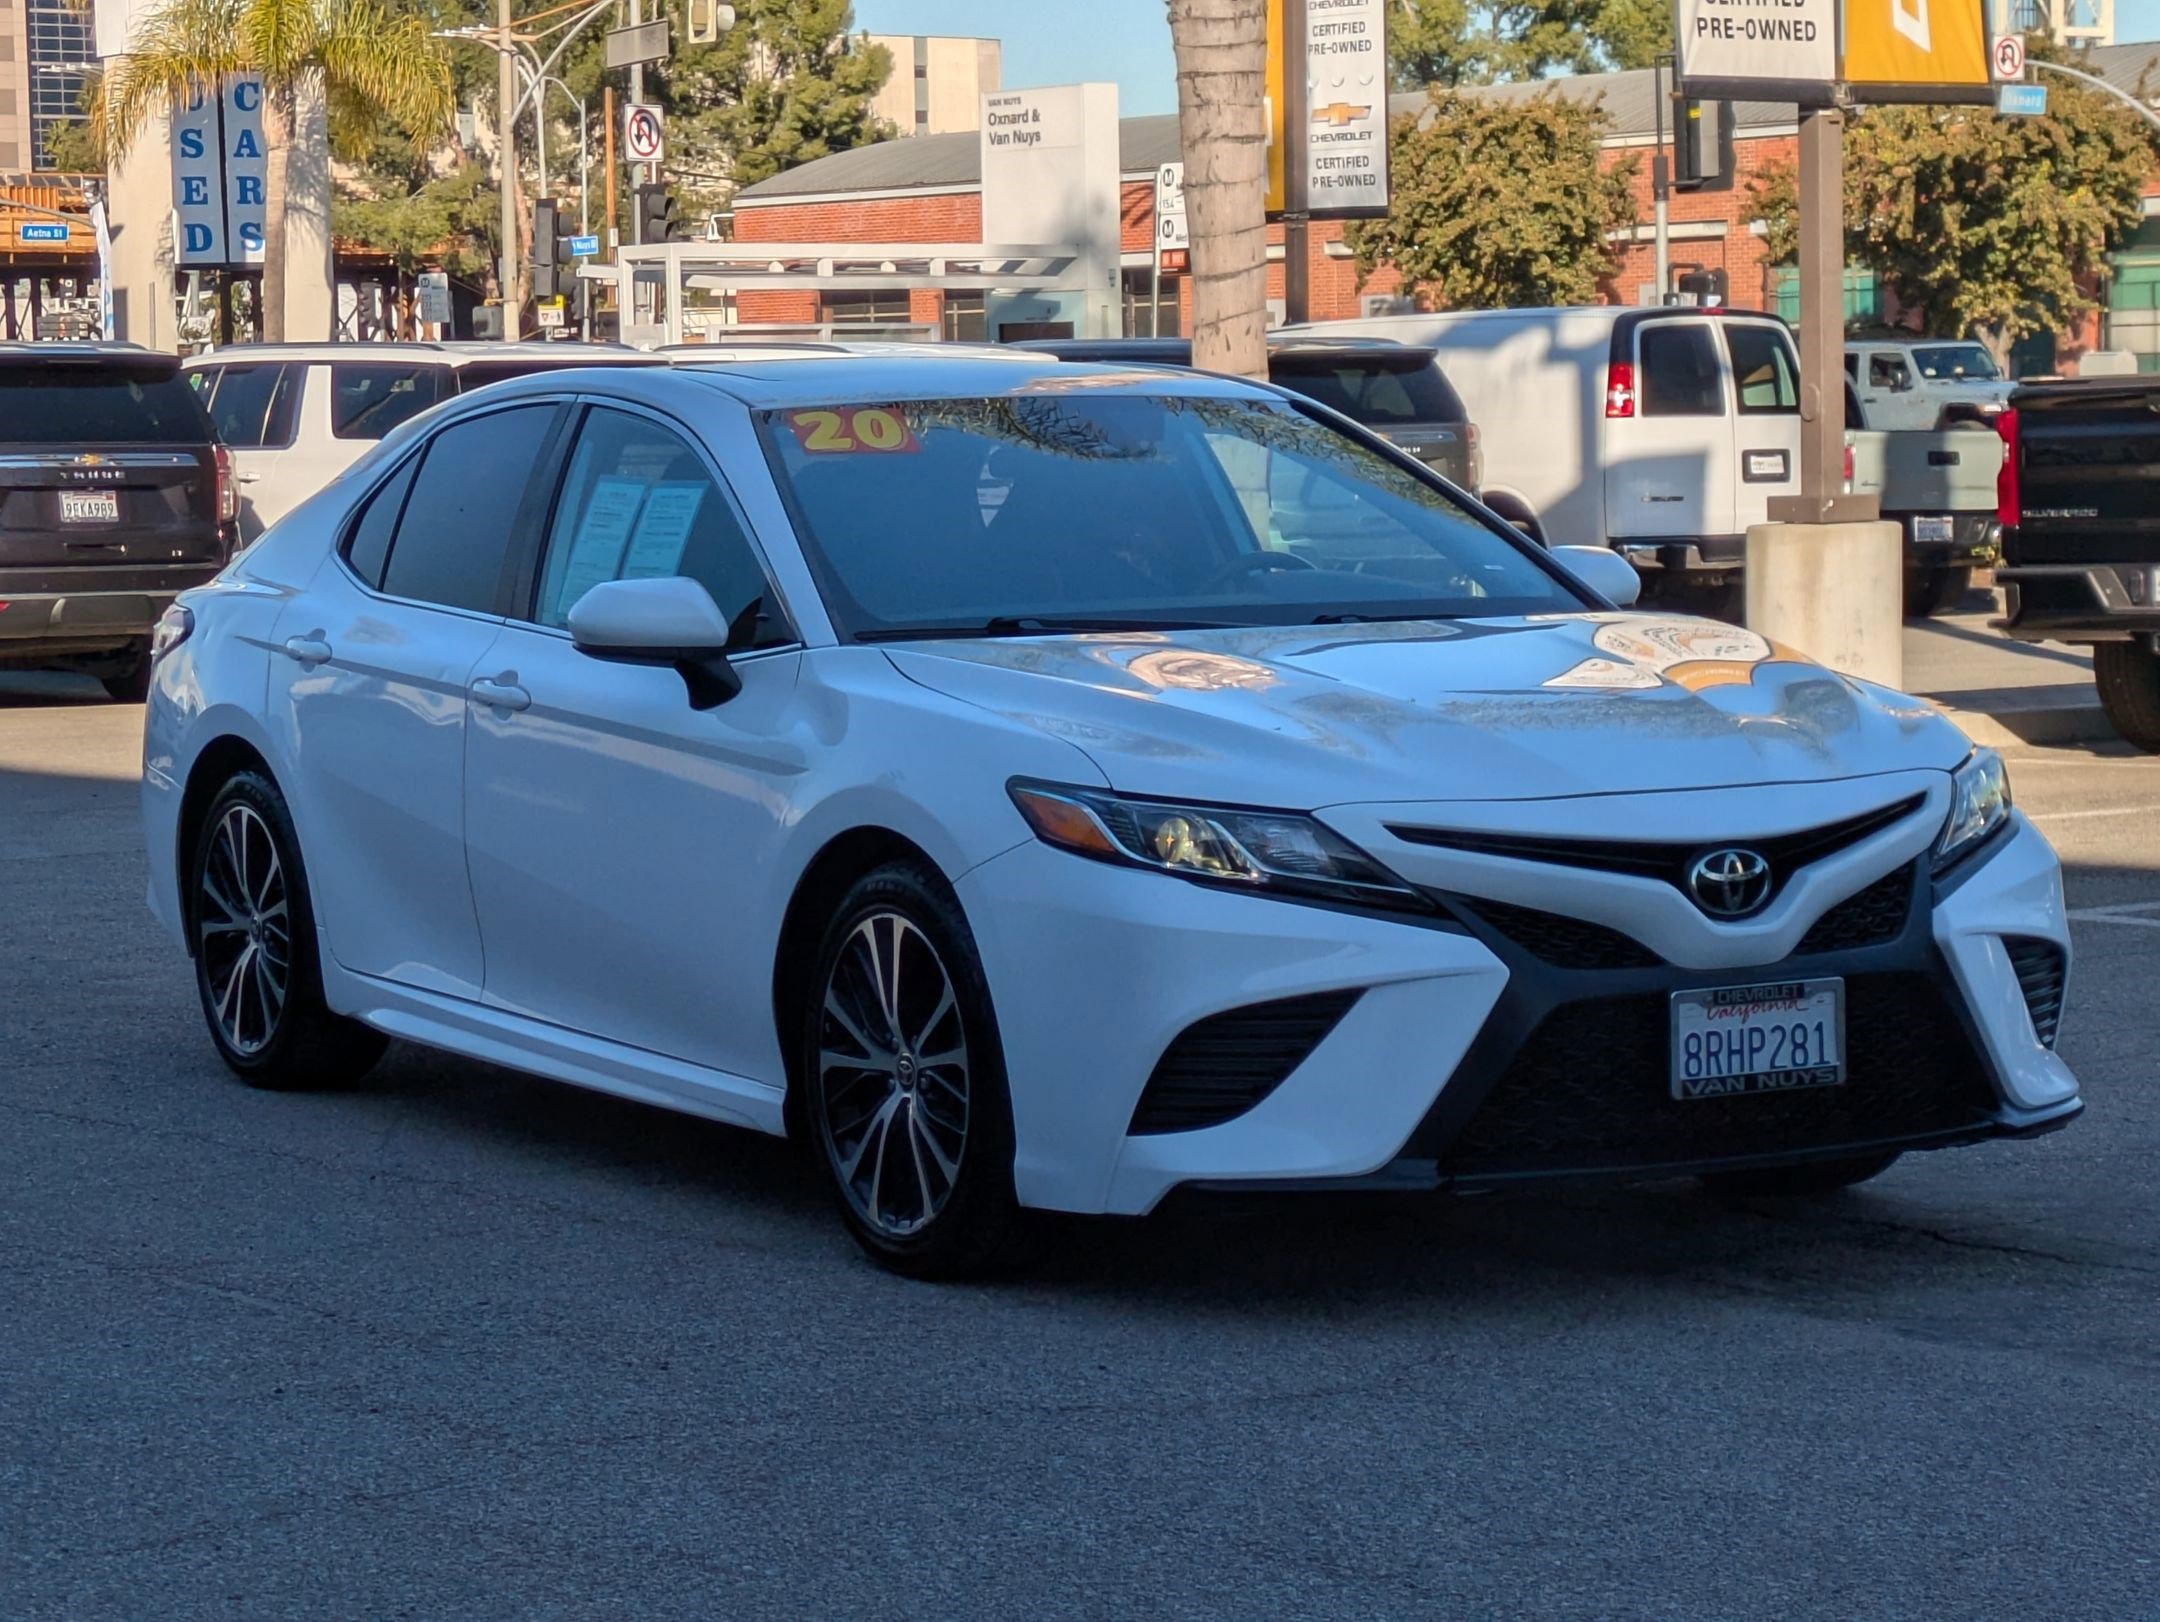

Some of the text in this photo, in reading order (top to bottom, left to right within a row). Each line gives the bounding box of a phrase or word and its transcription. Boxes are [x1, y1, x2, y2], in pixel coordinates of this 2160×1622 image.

[1312, 21, 1366, 37] CERTIFIED
[1696, 17, 1817, 42] PRE-OWNED
[1308, 40, 1372, 56] PRE-OWNED
[988, 108, 1040, 126] Oxnard &
[989, 130, 1041, 147] Van Nuys
[1310, 131, 1373, 143] CHEVROLET
[233, 81, 265, 252] CARS
[1316, 155, 1370, 170] CERTIFIED
[1312, 174, 1376, 189] PRE-OWNED
[793, 409, 906, 450] 20
[1718, 984, 1800, 1004] CHEVROLET
[1684, 1021, 1831, 1078] 8RHP281
[1683, 1068, 1838, 1097] VAN NUYS
